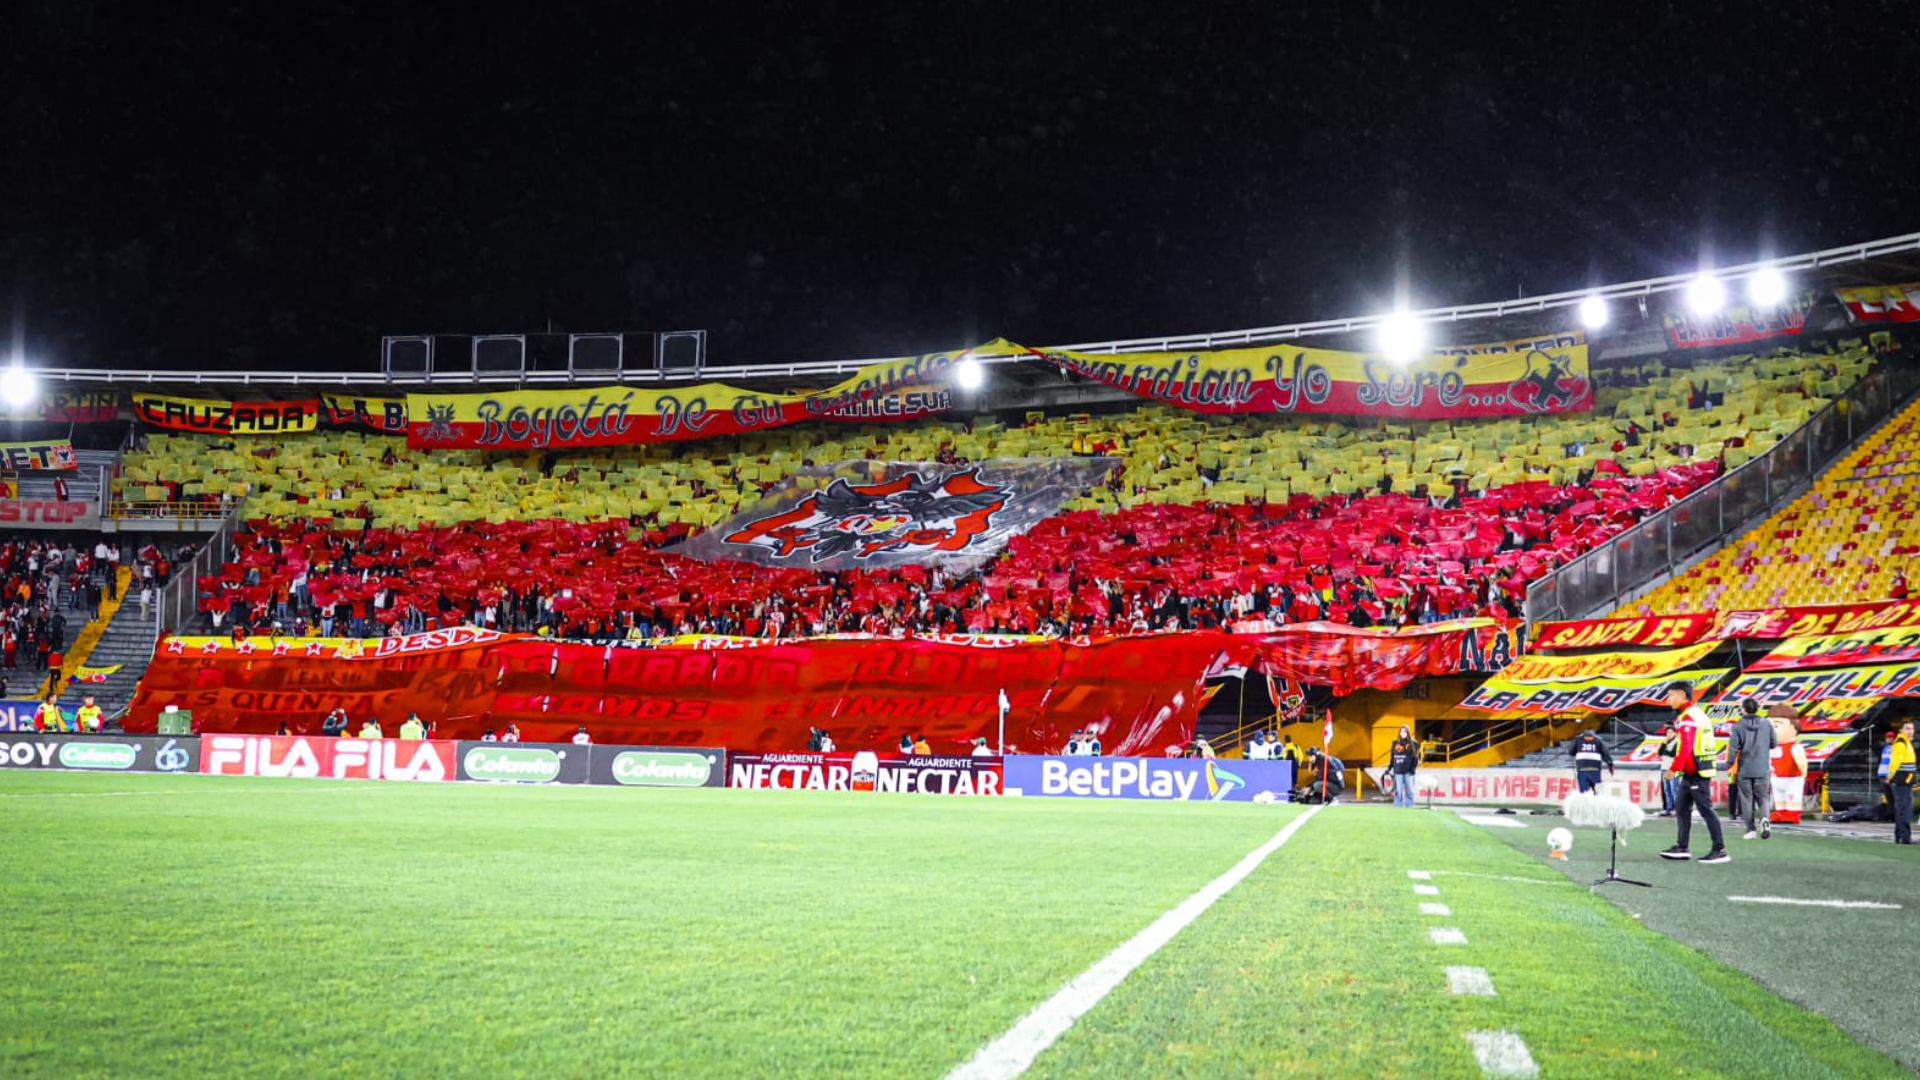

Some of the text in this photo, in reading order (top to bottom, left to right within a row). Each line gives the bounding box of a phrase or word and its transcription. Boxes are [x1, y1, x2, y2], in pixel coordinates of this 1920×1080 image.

[474, 391, 635, 447] Bogotá
[649, 395, 719, 436] De
[1265, 353, 1332, 413] Yo
[142, 398, 304, 432] CRUZADA
[382, 401, 409, 431] B
[1542, 618, 1647, 647] SANTA
[1640, 617, 1692, 646] FE
[1460, 687, 1519, 710] LA
[210, 737, 319, 776] FILA
[334, 740, 445, 781] FILA
[466, 751, 558, 775] Colanta
[614, 757, 707, 779] Colanta
[762, 753, 824, 764] AGUARDIENTE
[908, 757, 972, 768] AGUARDIENTE
[731, 763, 849, 791] NECTAR
[878, 766, 1000, 795] NECTAR
[1042, 759, 1198, 801] BetPlay
[1493, 775, 1541, 798] MAS
